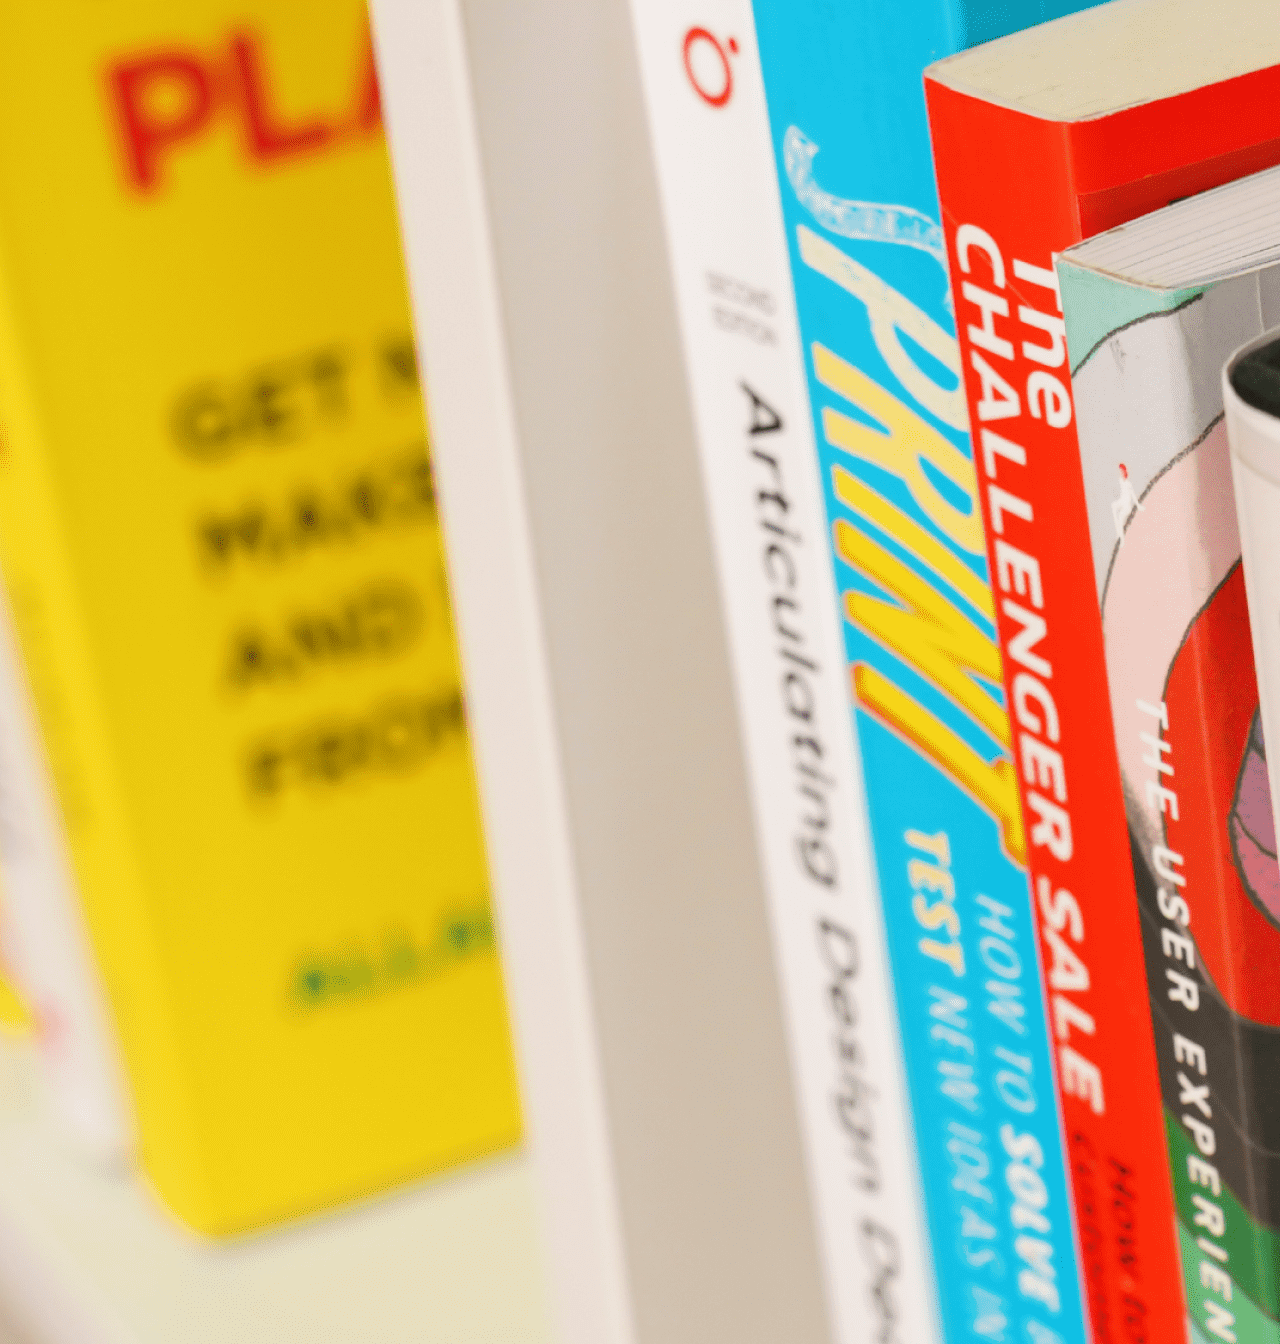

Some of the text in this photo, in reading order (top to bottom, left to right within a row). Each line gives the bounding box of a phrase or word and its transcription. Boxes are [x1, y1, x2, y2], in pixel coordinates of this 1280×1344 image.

[954, 222, 1105, 1116] The CHALLENGER SALE
[737, 376, 840, 894] Articulating
[814, 912, 885, 1198] Design
[1136, 697, 1179, 822] THE
[903, 826, 966, 978] TEST
[974, 891, 1026, 1037] HOW
[1151, 843, 1201, 1013] USER
[928, 984, 984, 1114] NEW
[994, 1043, 1038, 1115] TO
[1002, 1121, 1062, 1313] SOLVE
